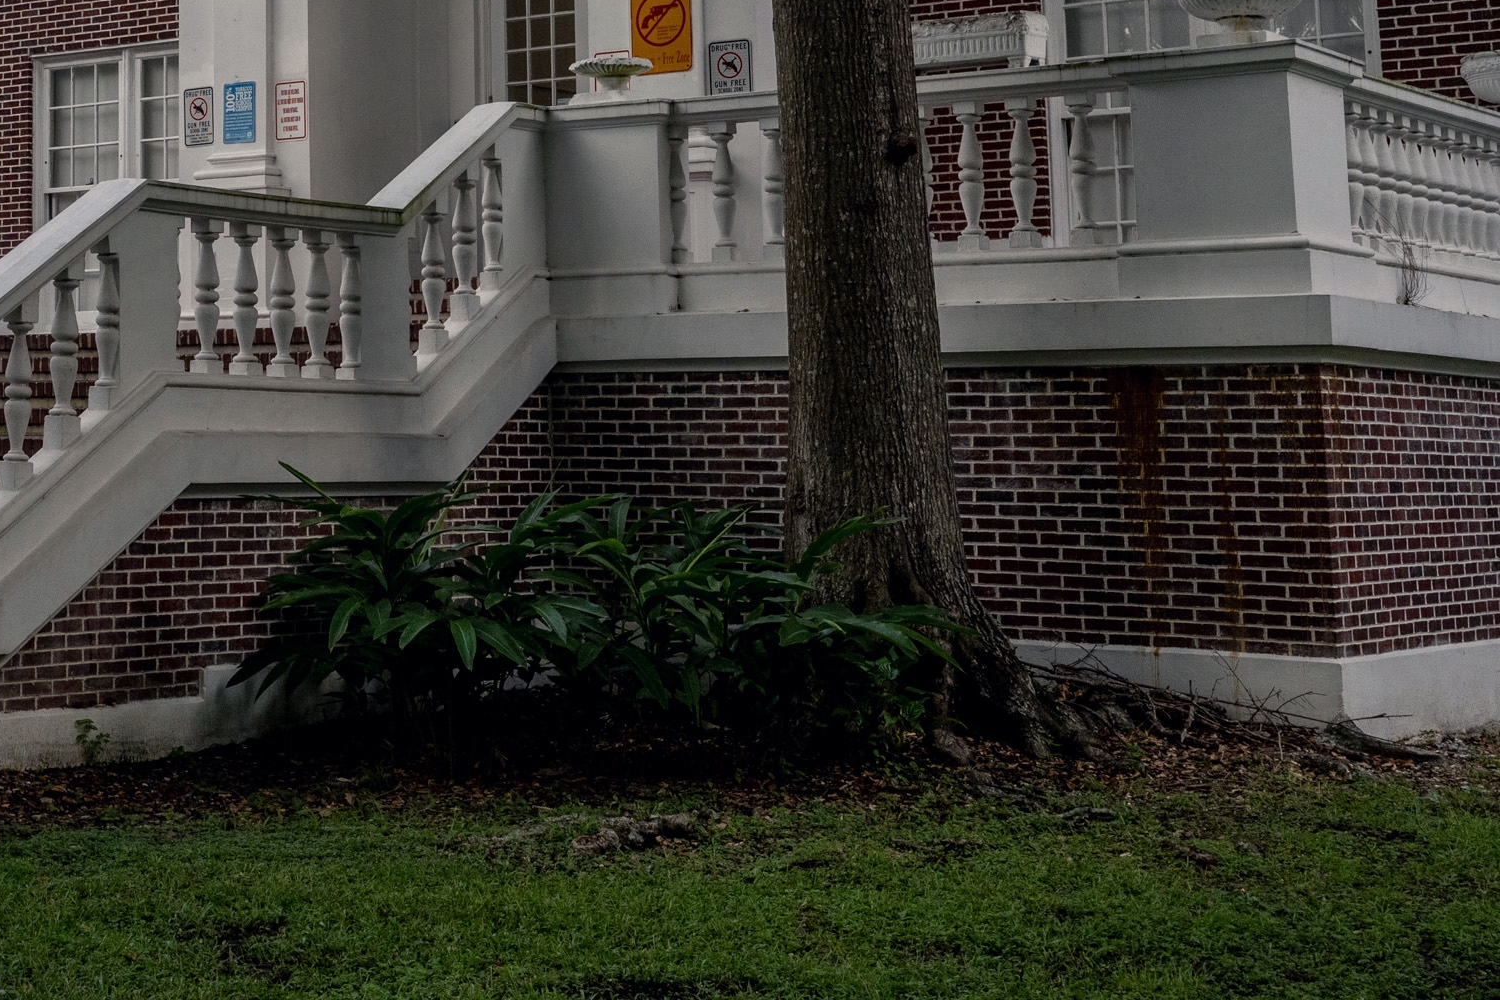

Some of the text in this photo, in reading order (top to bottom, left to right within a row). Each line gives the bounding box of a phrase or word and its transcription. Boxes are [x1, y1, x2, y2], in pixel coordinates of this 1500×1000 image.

[677, 50, 691, 63] Zone
[731, 79, 747, 87] FREE
[235, 91, 253, 101] FREE
